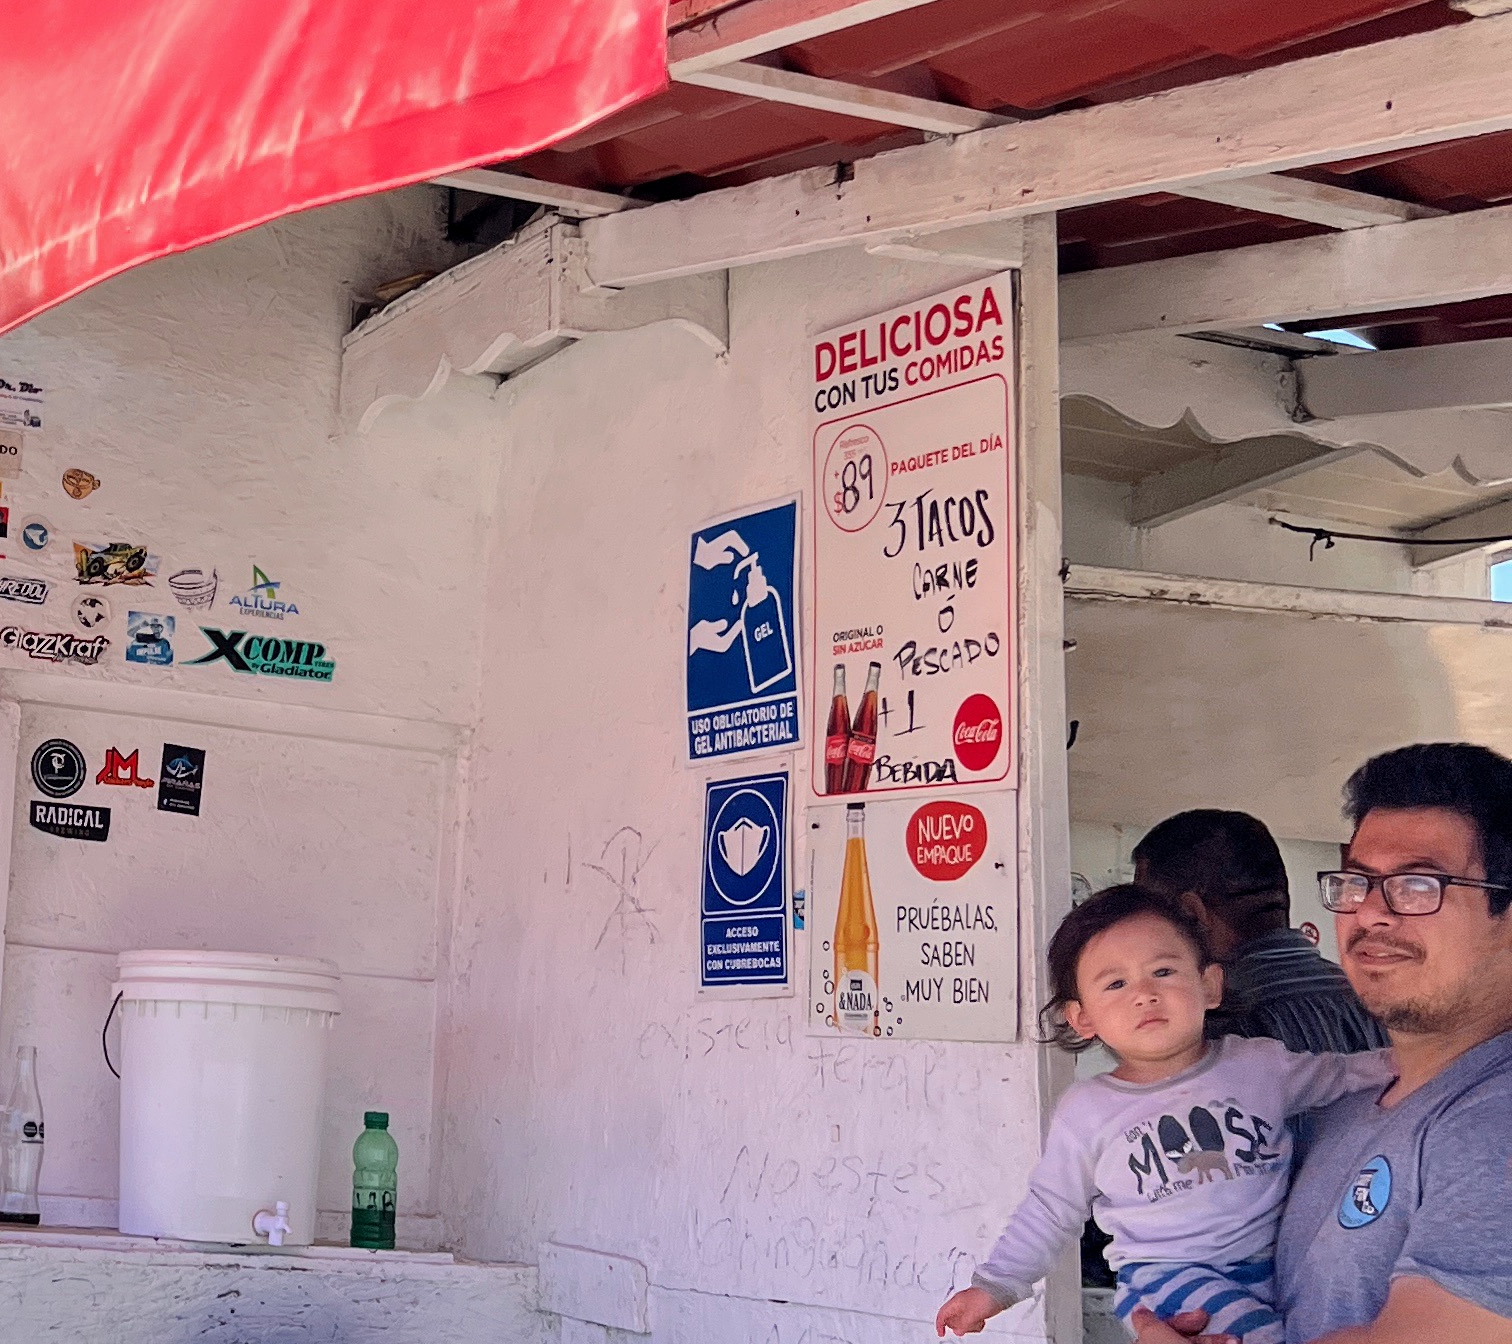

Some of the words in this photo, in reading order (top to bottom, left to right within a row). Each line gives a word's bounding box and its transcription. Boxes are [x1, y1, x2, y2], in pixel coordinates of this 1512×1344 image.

[815, 286, 1003, 383] DELICIOSA
[815, 379, 856, 413] CON
[860, 367, 899, 399] TUS
[904, 335, 1004, 386] COMIDAS
[890, 448, 949, 476] PAQUETE
[952, 441, 976, 461] DEL
[979, 432, 1004, 454] DÍA
[883, 500, 906, 558] 3
[909, 488, 995, 552] TACOS
[912, 558, 979, 601] CARNE
[228, 592, 300, 615] ALTURA
[754, 621, 774, 642] GEL
[832, 627, 875, 643] ORIGINAL
[832, 642, 847, 656] SIN
[893, 632, 1000, 681] PESCADO
[260, 663, 332, 680] Gladiator
[691, 717, 711, 735] USO
[712, 704, 778, 731] OBLIGATORIO
[779, 701, 794, 719] DE
[694, 733, 713, 755] GEL
[714, 720, 793, 752] ANTIBACTERIAL
[872, 754, 959, 785] BEBIDA
[917, 813, 974, 844] NUEVO
[916, 843, 973, 865] EMPAQUE
[896, 897, 998, 933] PRUÉBALAS,
[725, 926, 759, 938] ACCESO
[706, 940, 781, 956] EXCLUSIVAMENTE
[920, 941, 976, 968] SABEN
[706, 959, 724, 972] CON
[724, 956, 782, 970] CUBREBOCAS
[905, 976, 944, 1003] MUY
[953, 977, 990, 1004] BIEN
[1146, 1182, 1173, 1204] with
[1173, 1178, 1194, 1192] me
